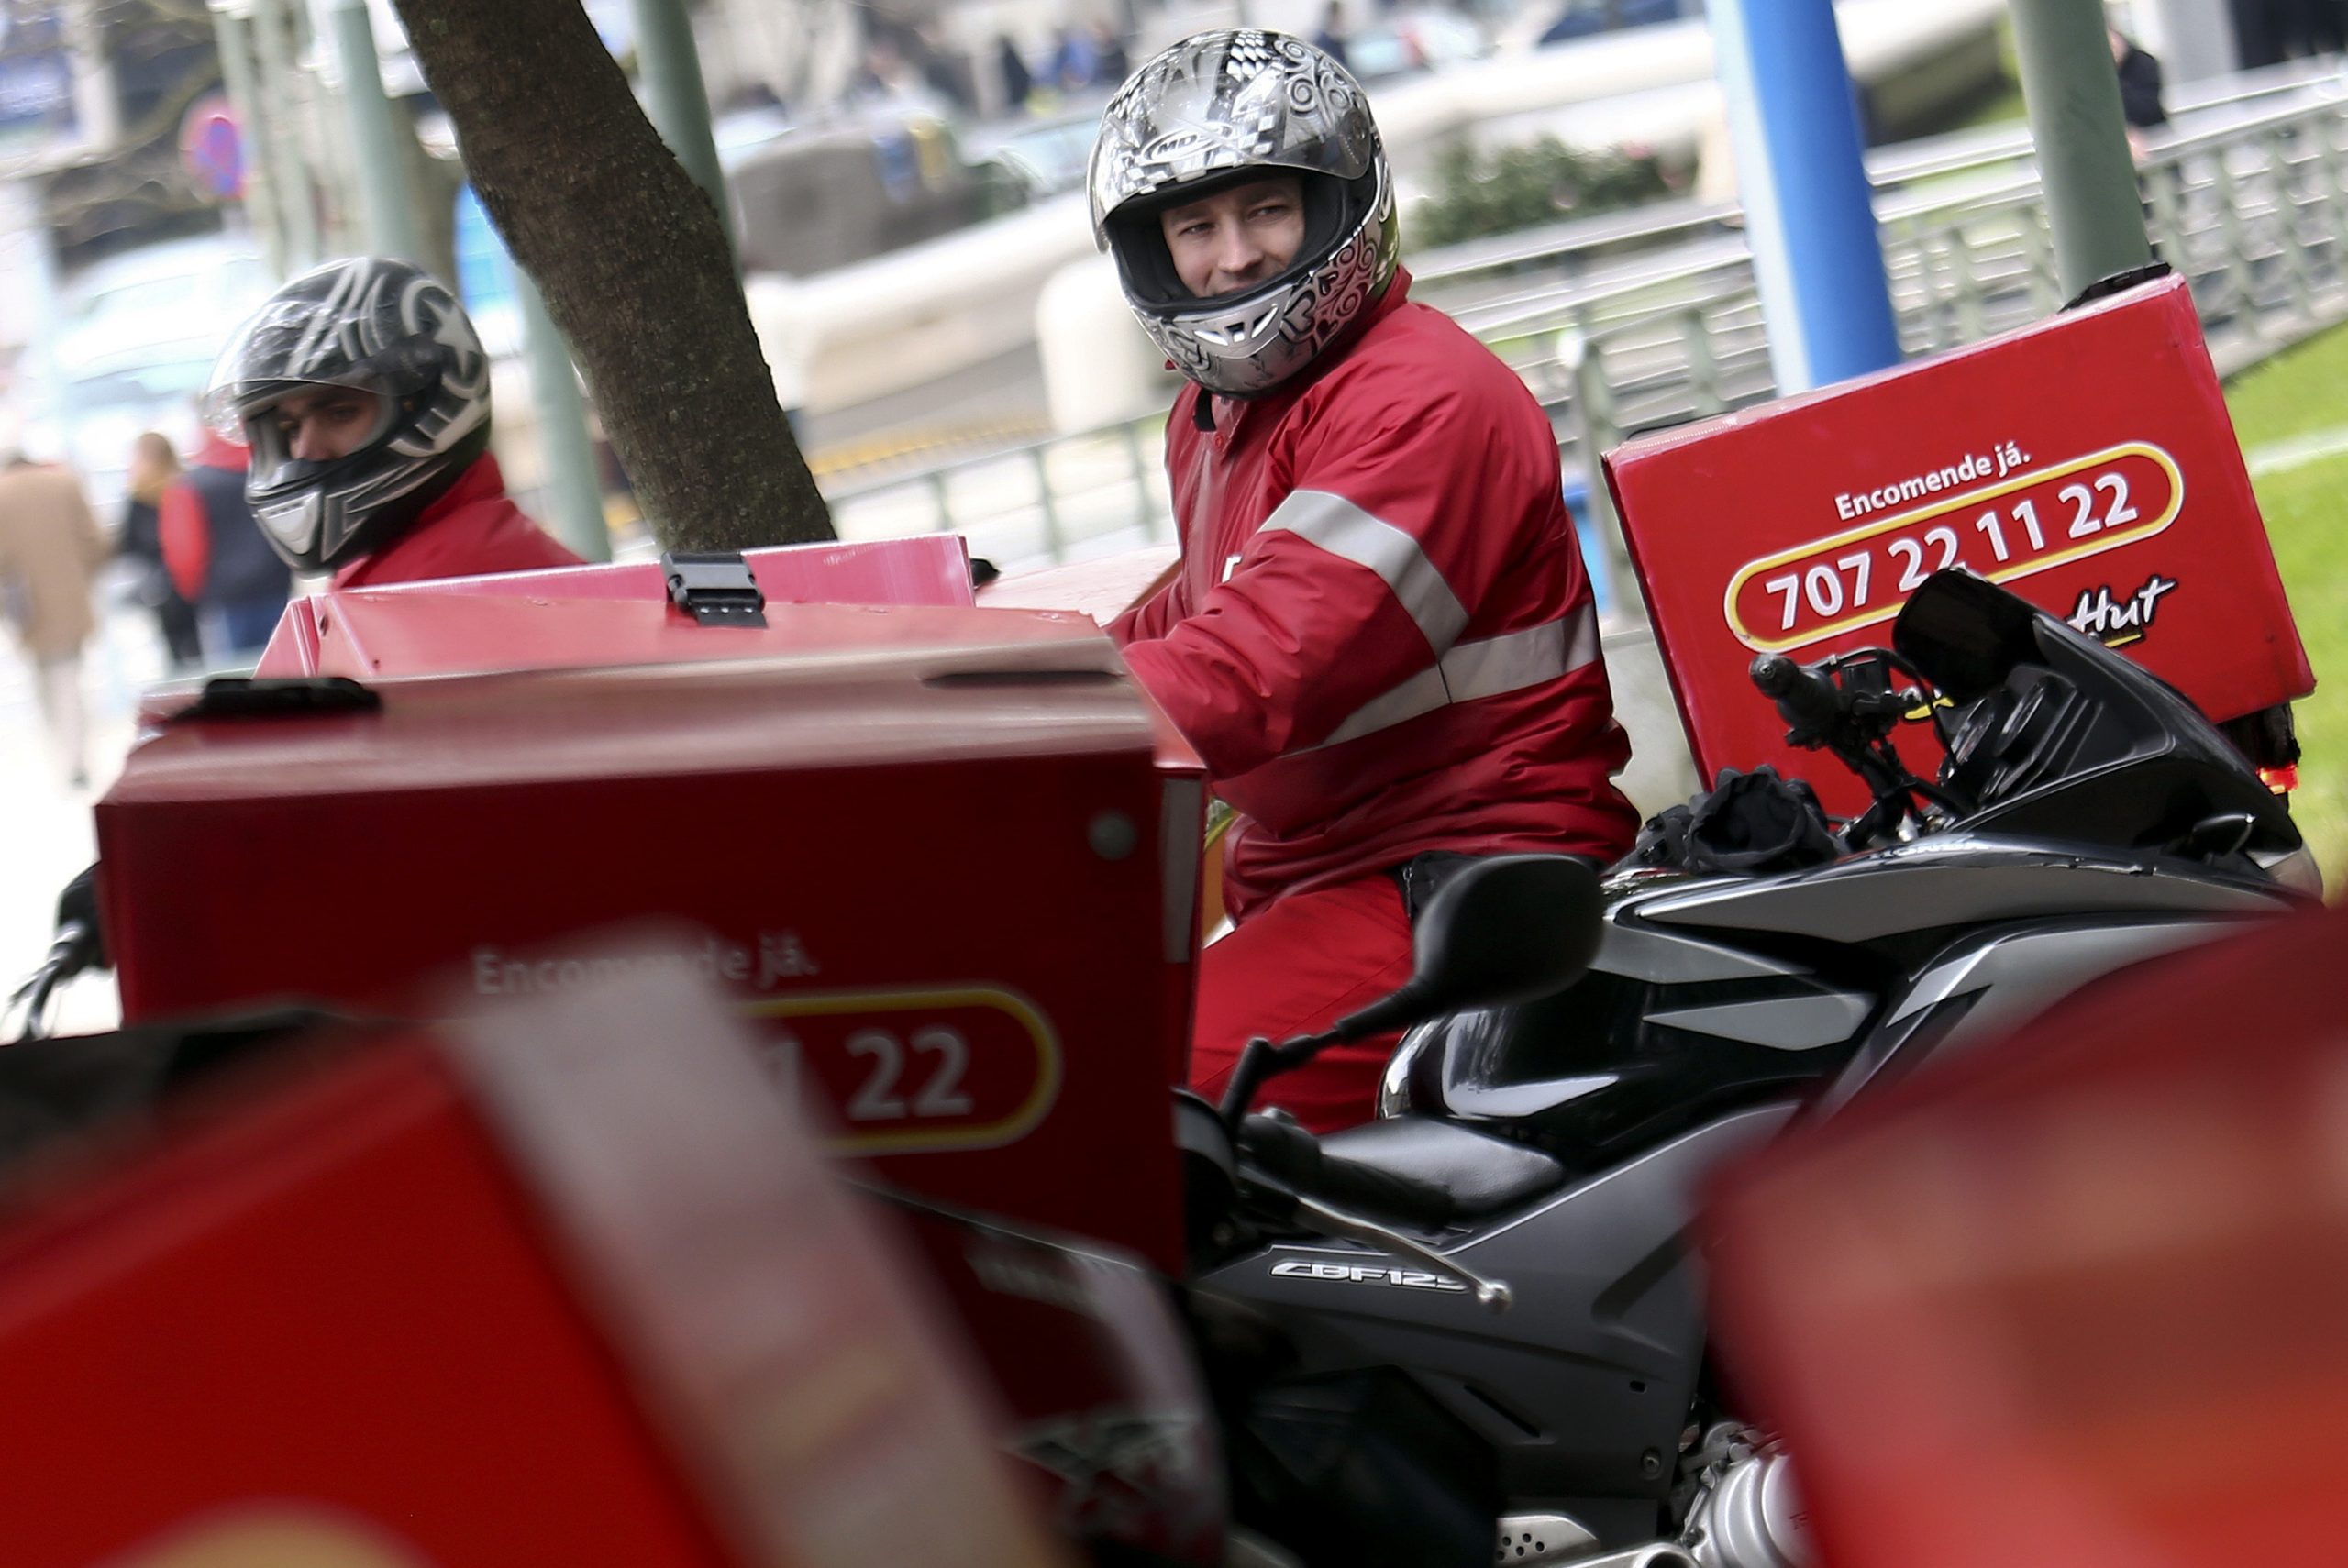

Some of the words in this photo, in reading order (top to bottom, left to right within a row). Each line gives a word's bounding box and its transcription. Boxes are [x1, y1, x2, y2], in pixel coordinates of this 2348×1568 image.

[1834, 454, 1992, 521] Encomende
[1994, 440, 2032, 479] já.
[1765, 551, 1872, 631] 707
[1888, 526, 1967, 593] 22
[1975, 500, 2045, 562] 11
[2057, 472, 2139, 539] 22
[2066, 577, 2177, 633] Hut
[757, 926, 823, 990] já.
[845, 1027, 974, 1121] 22
